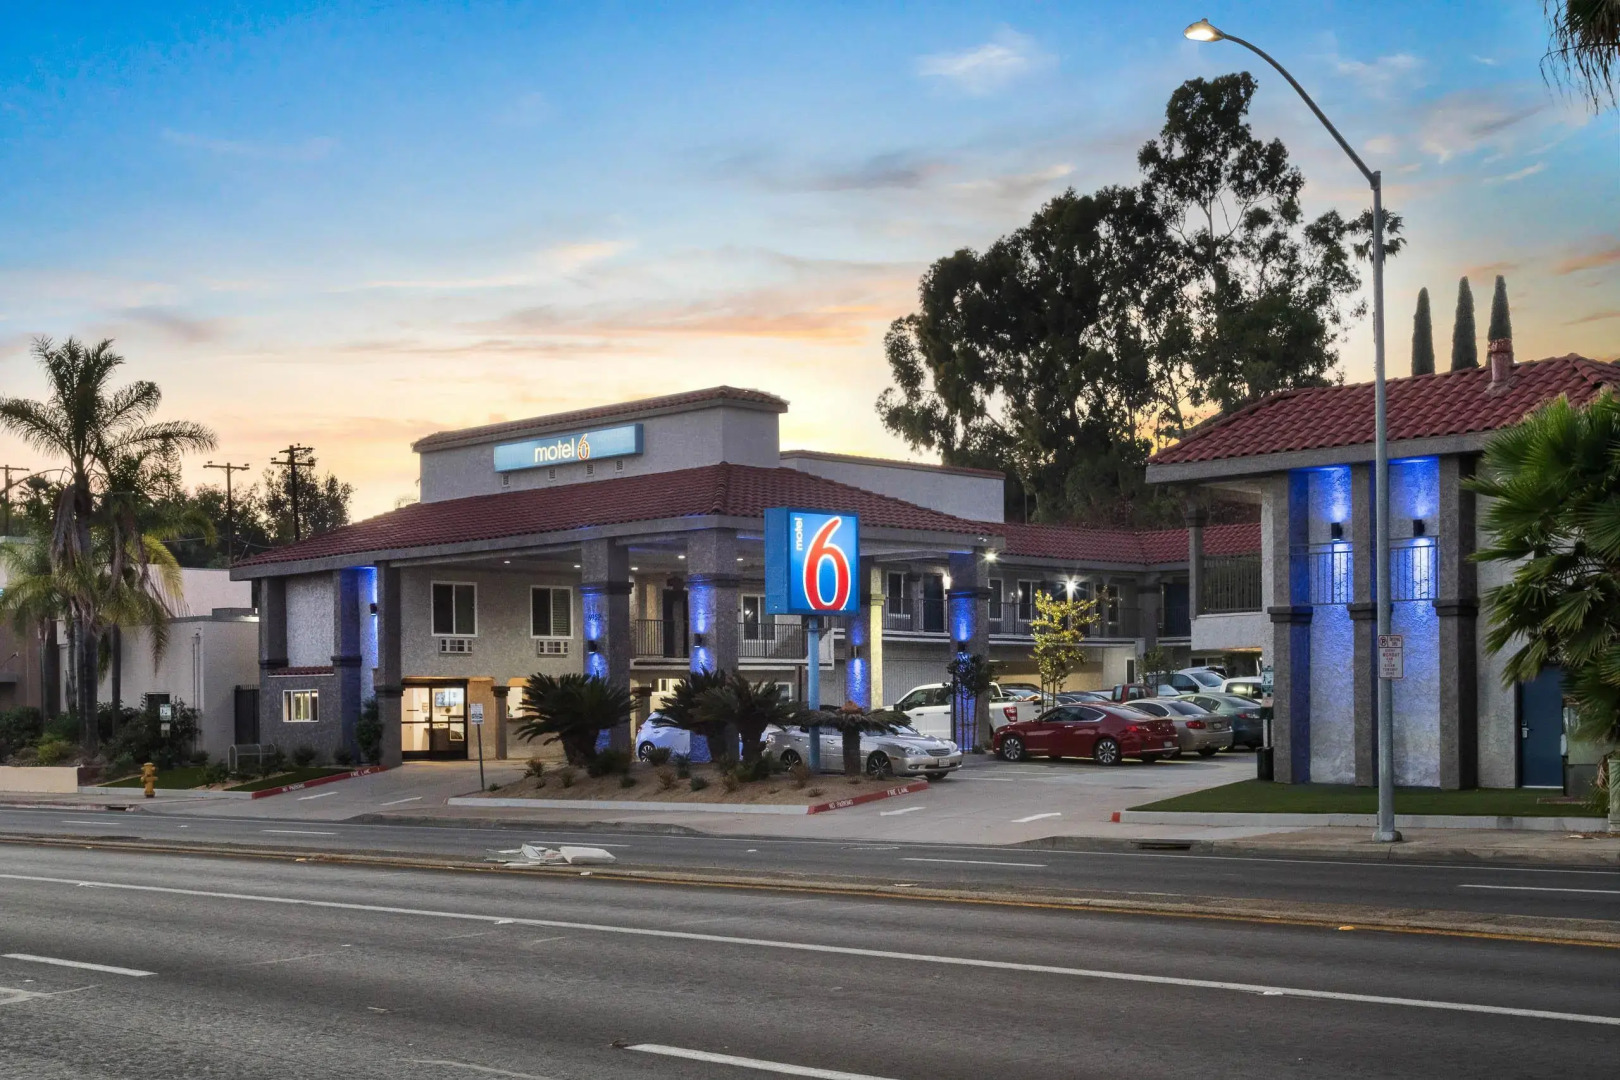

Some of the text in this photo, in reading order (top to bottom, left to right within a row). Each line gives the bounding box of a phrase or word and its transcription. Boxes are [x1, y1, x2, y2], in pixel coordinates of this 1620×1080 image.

[534, 433, 590, 463] motel 6
[794, 516, 851, 611] motel 6
